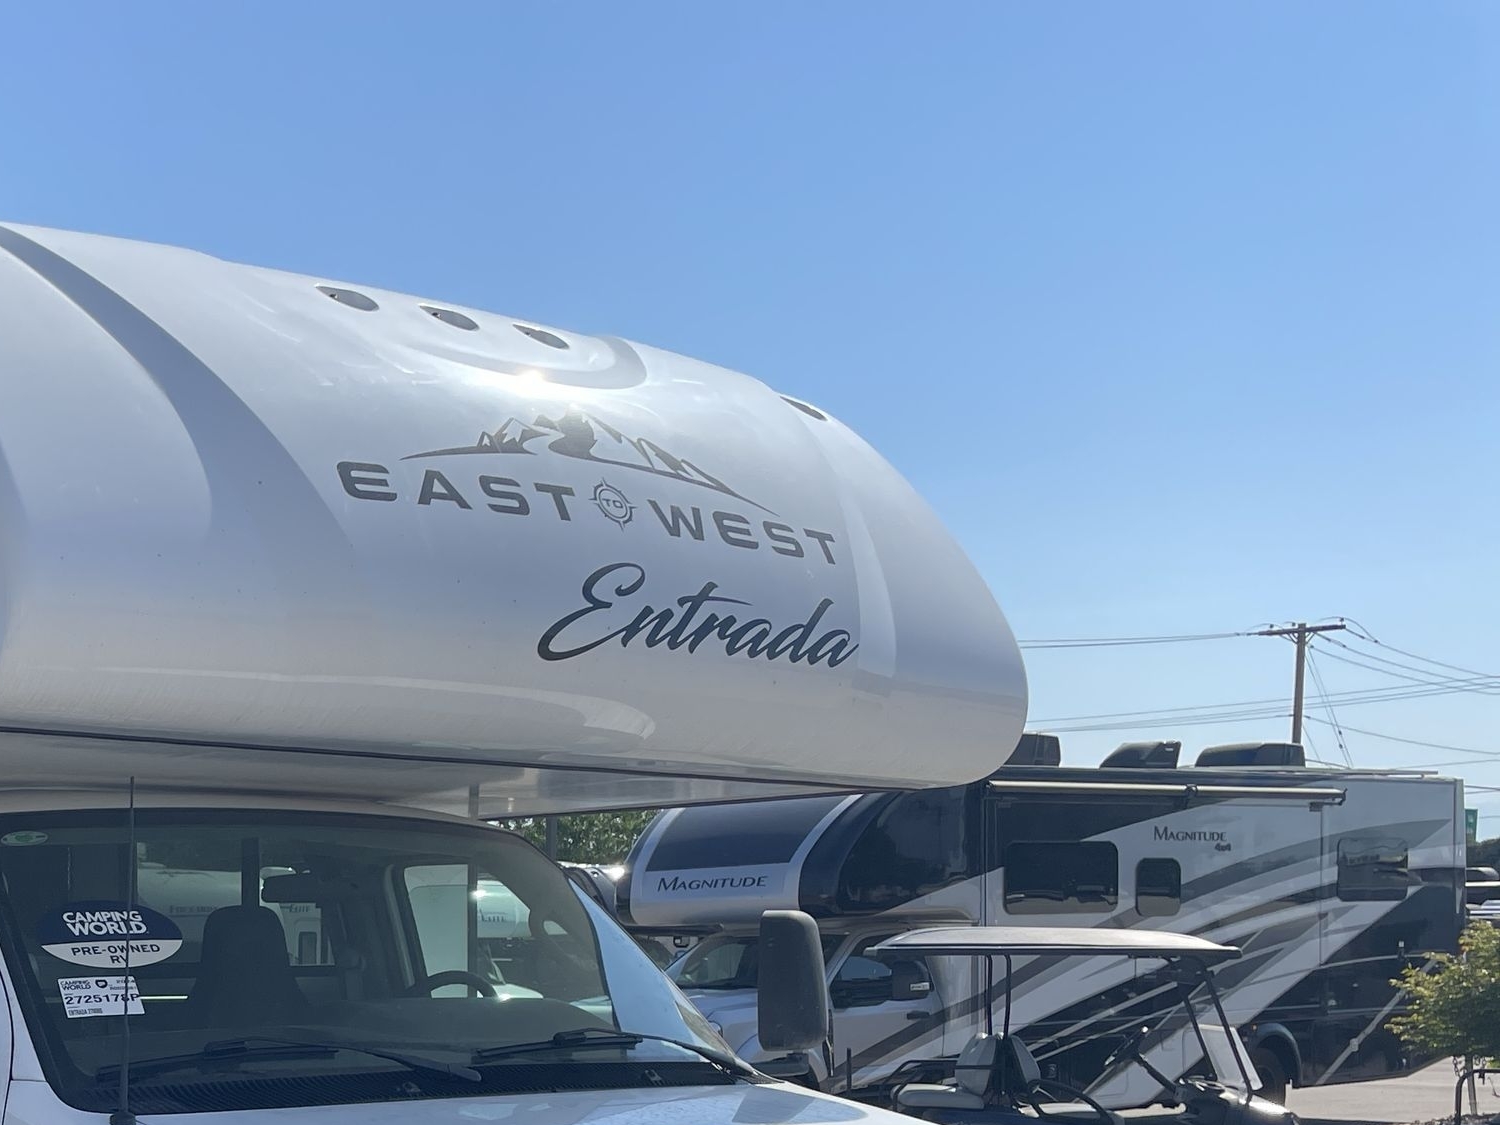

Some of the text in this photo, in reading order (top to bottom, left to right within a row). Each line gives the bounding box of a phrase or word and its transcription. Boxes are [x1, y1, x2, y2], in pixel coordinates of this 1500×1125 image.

[336, 461, 835, 565] EAST TO WEST
[537, 562, 859, 668] Entrada
[62, 911, 143, 923] CAMPING
[66, 921, 147, 936] WORLD
[71, 944, 160, 956] PRE-OWNED
